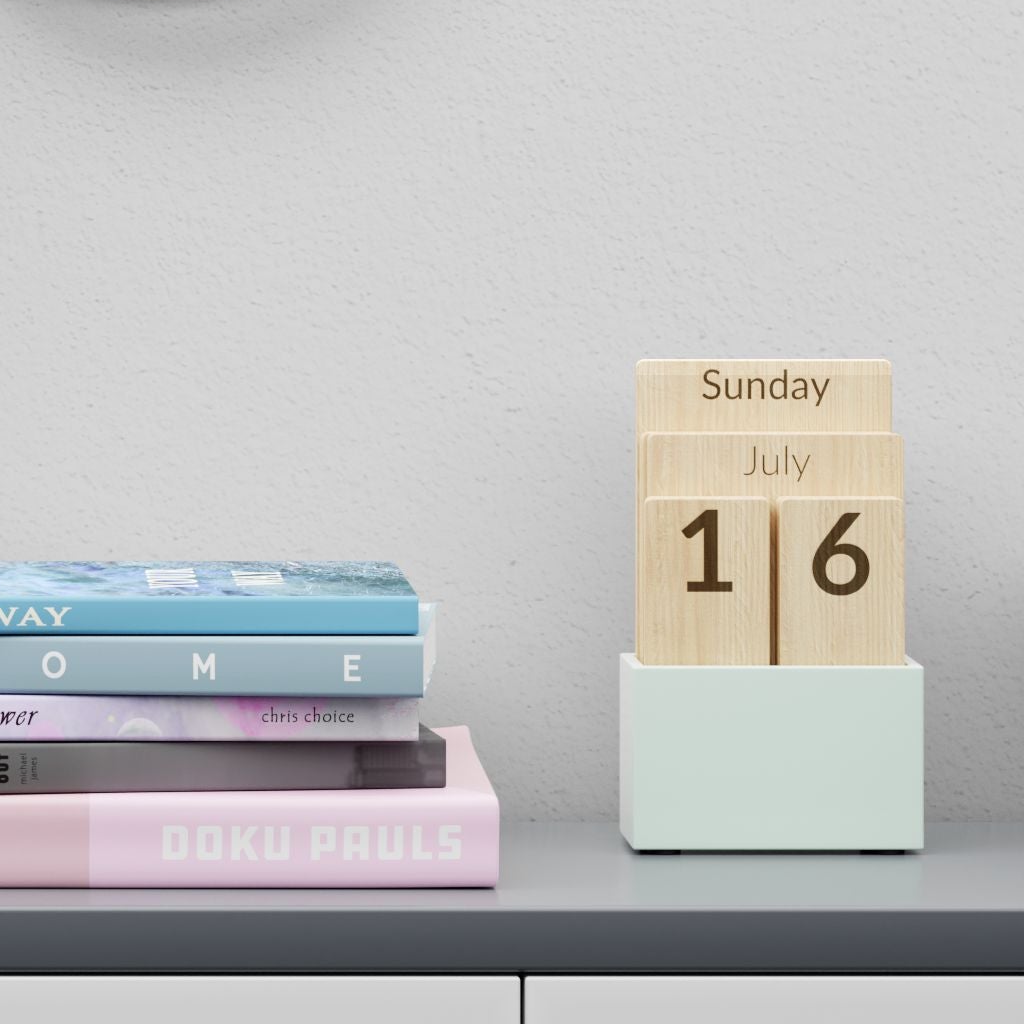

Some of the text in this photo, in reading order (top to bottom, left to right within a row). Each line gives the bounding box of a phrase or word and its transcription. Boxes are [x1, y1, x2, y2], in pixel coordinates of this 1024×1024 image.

[702, 369, 830, 406] Sunday
[743, 445, 811, 482] July
[261, 707, 355, 724] chris choice
[162, 825, 462, 861] DOKU PAULS
